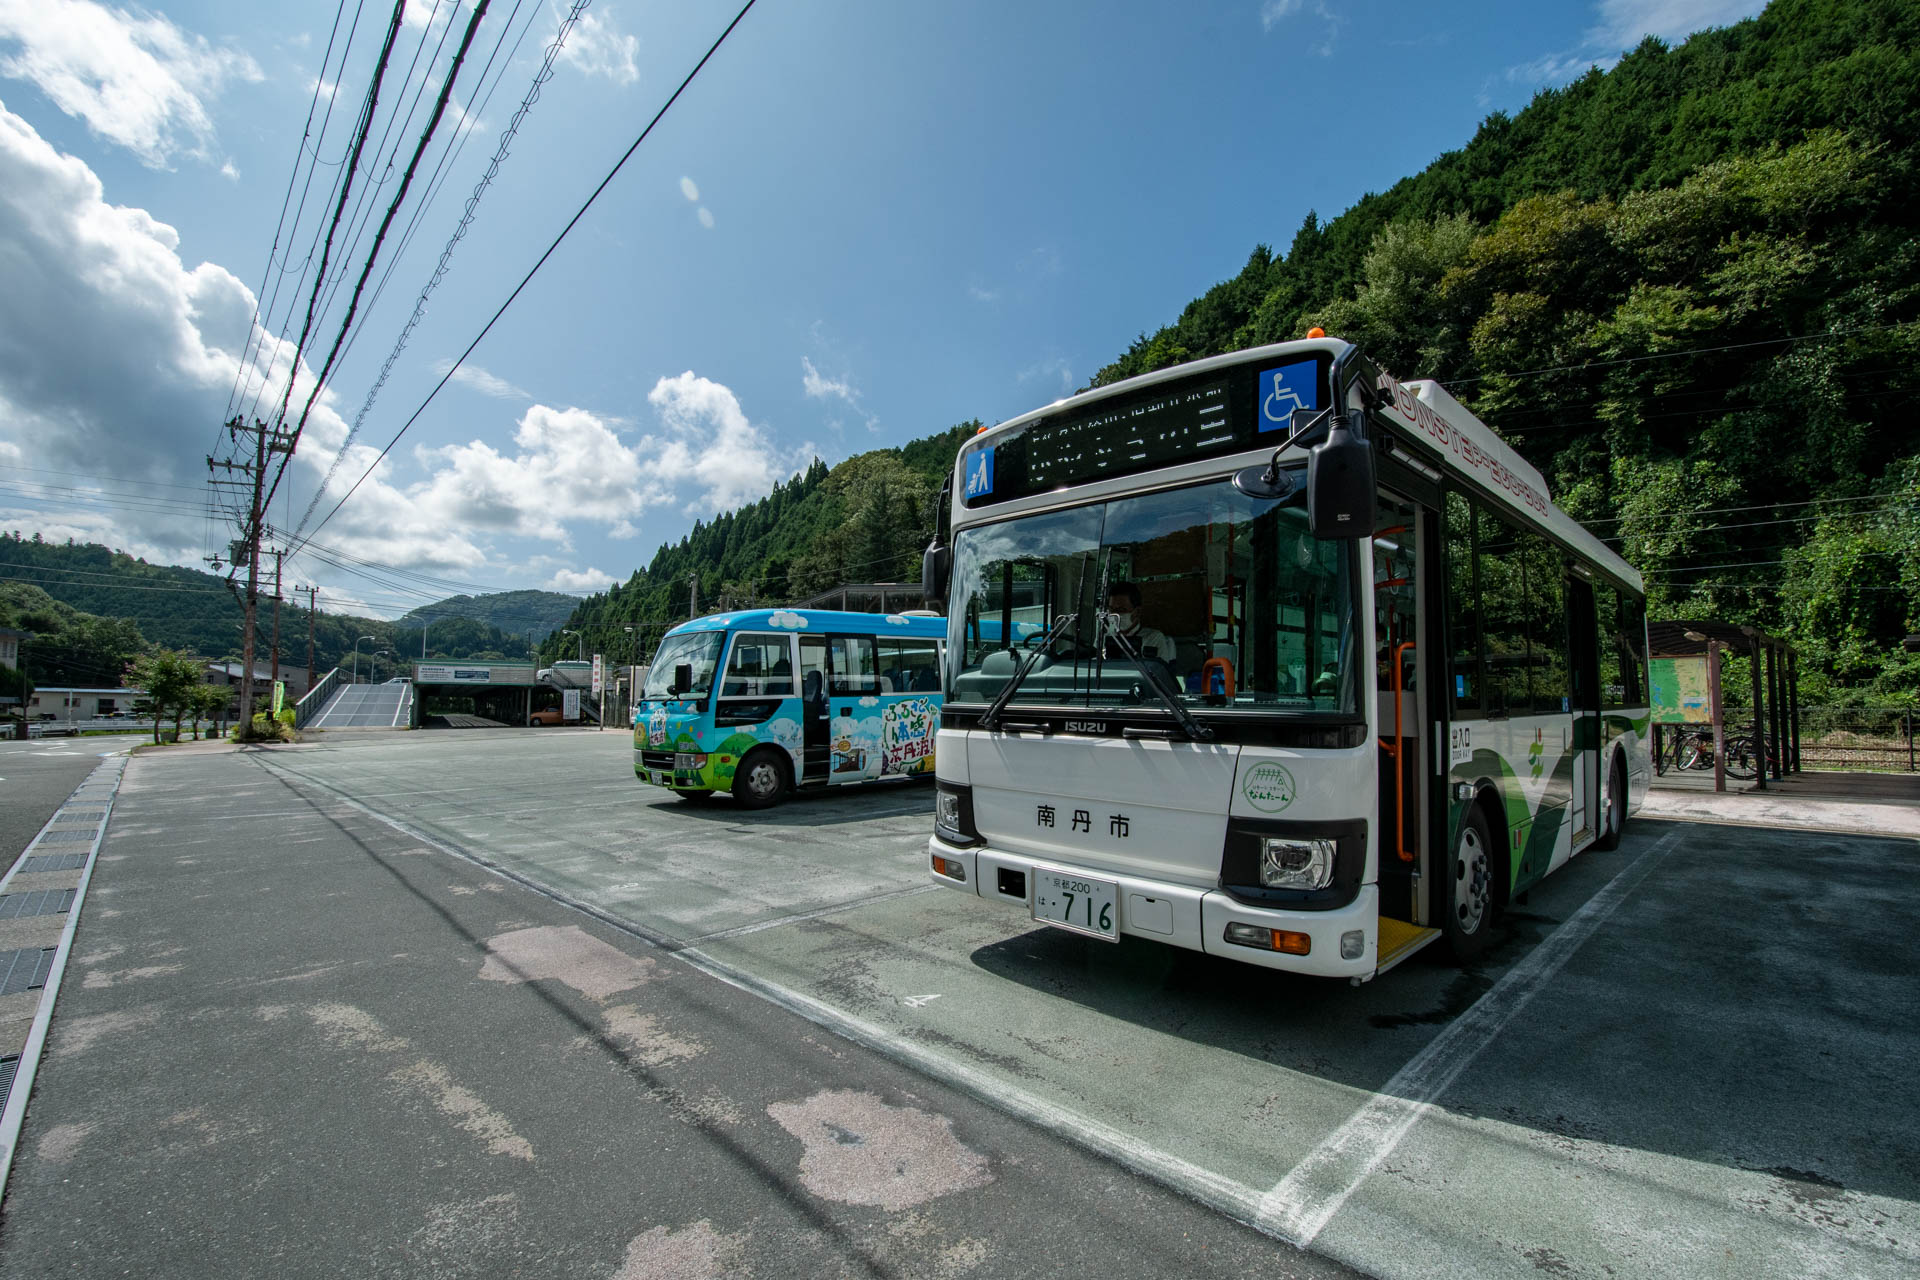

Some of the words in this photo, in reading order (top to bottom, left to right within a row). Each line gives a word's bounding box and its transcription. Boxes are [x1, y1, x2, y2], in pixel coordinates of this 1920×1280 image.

[1064, 721, 1106, 733] ISUZU
[1249, 789, 1289, 801] なんたーん
[1037, 804, 1130, 838] 南丹市
